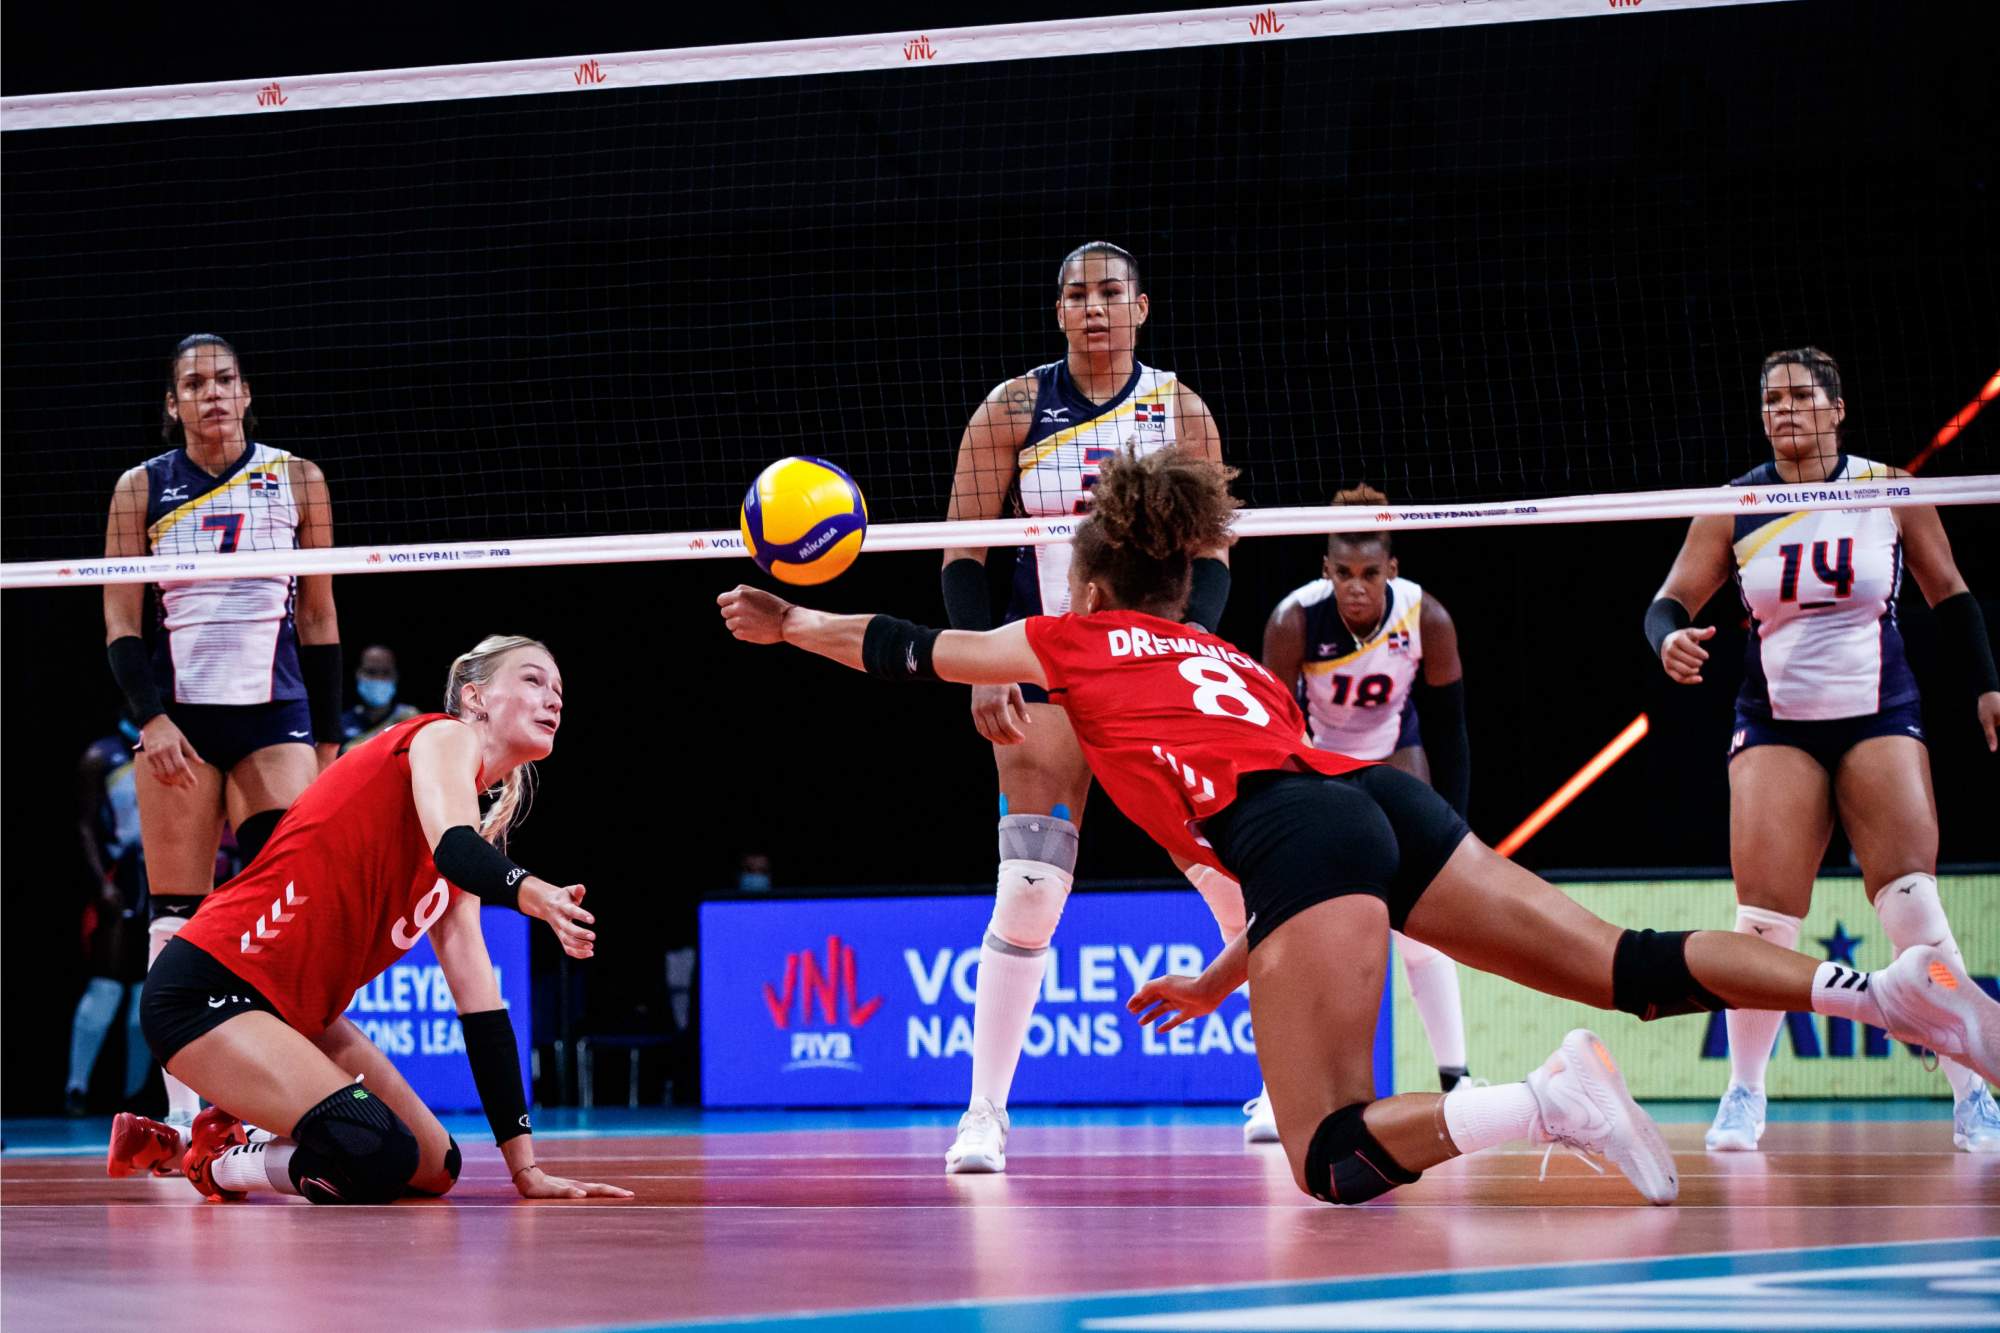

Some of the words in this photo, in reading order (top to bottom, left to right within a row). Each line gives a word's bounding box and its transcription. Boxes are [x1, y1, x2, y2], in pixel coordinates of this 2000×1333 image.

[1249, 8, 1285, 36] VNL
[903, 34, 938, 61] VNL
[574, 59, 607, 85] VNL
[1766, 490, 1852, 504] VOLLEYBALL
[1886, 486, 1911, 496] FIVB
[1400, 510, 1483, 521] VOLLEYBALL
[201, 512, 245, 554] 7
[389, 551, 461, 563] VOLLEYBALL
[1779, 537, 1855, 603] 14
[1178, 656, 1271, 728] 8
[1331, 673, 1395, 709] 18
[762, 934, 885, 1029] VNL
[790, 1032, 853, 1060] FIVB
